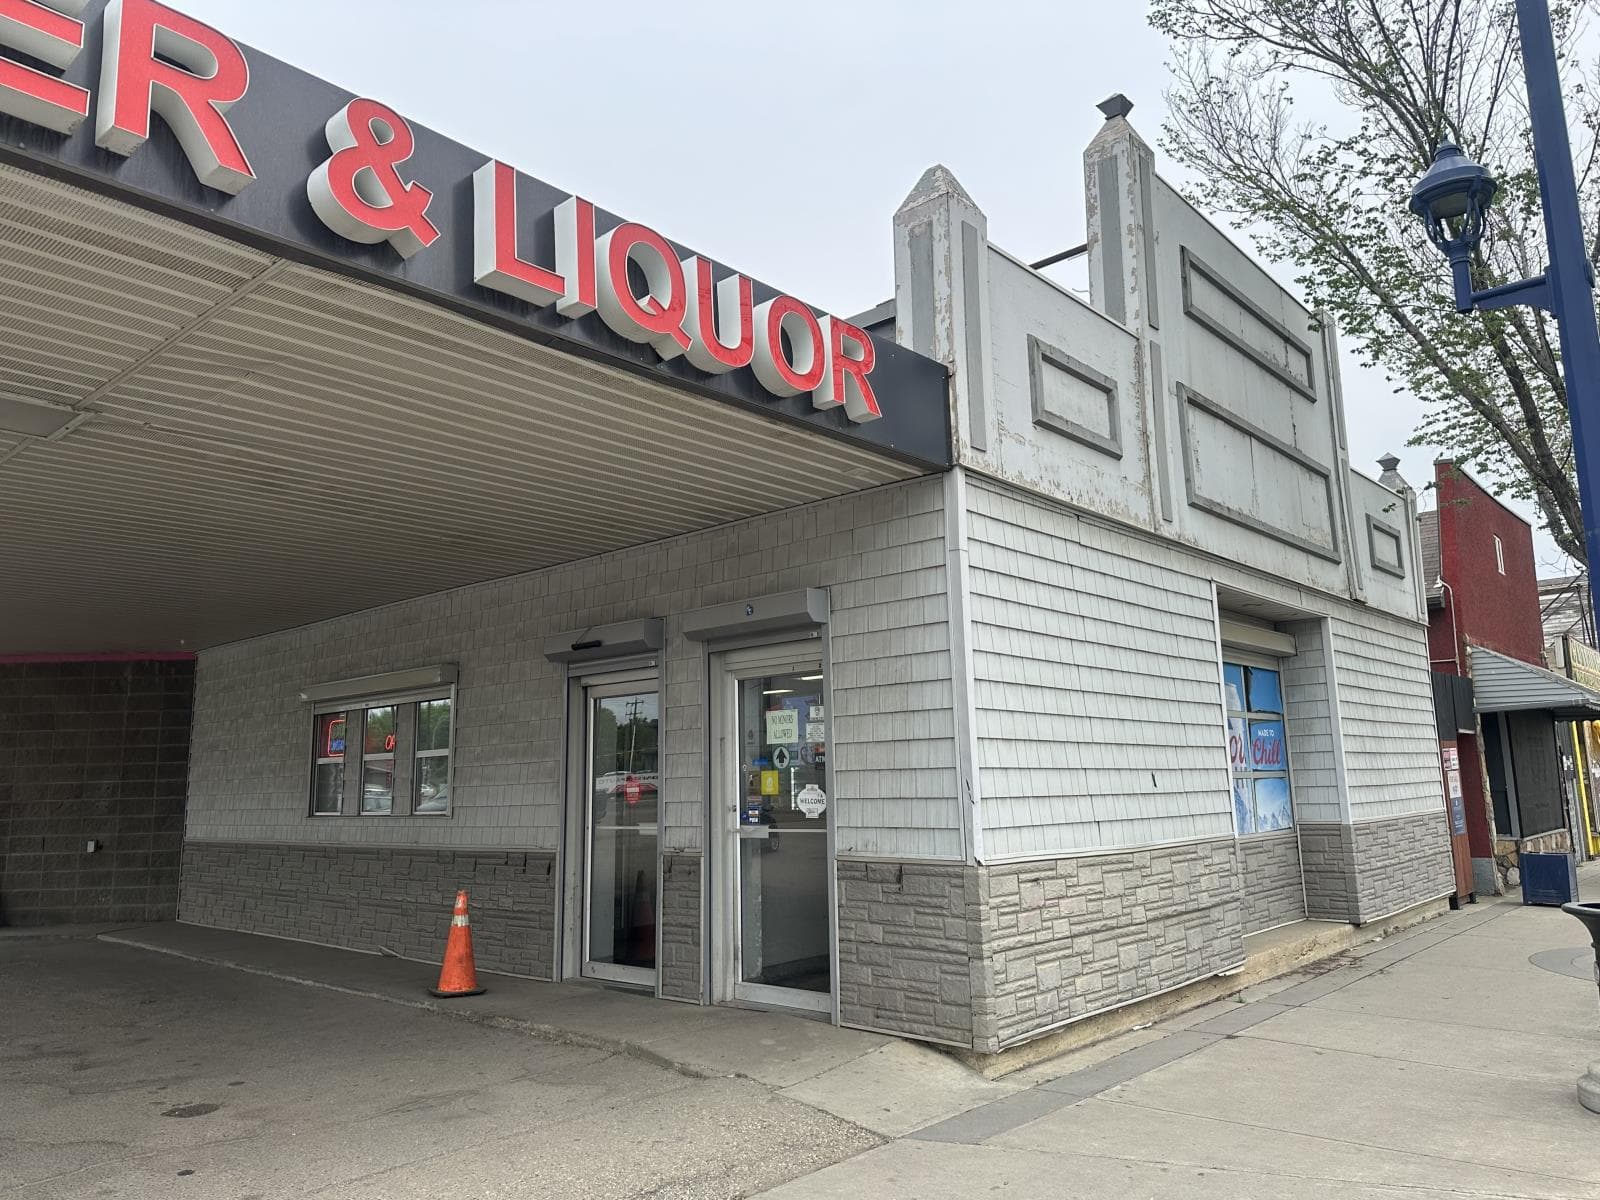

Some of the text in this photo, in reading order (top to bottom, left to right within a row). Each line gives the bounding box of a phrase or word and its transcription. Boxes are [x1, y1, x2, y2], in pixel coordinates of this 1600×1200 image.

[313, 97, 440, 252] &
[478, 159, 882, 421] LIQUOR
[778, 714, 794, 724] MINORS
[774, 729, 792, 739] ALLOWED
[1253, 738, 1280, 764] Chill
[800, 798, 825, 806] WELCOME
